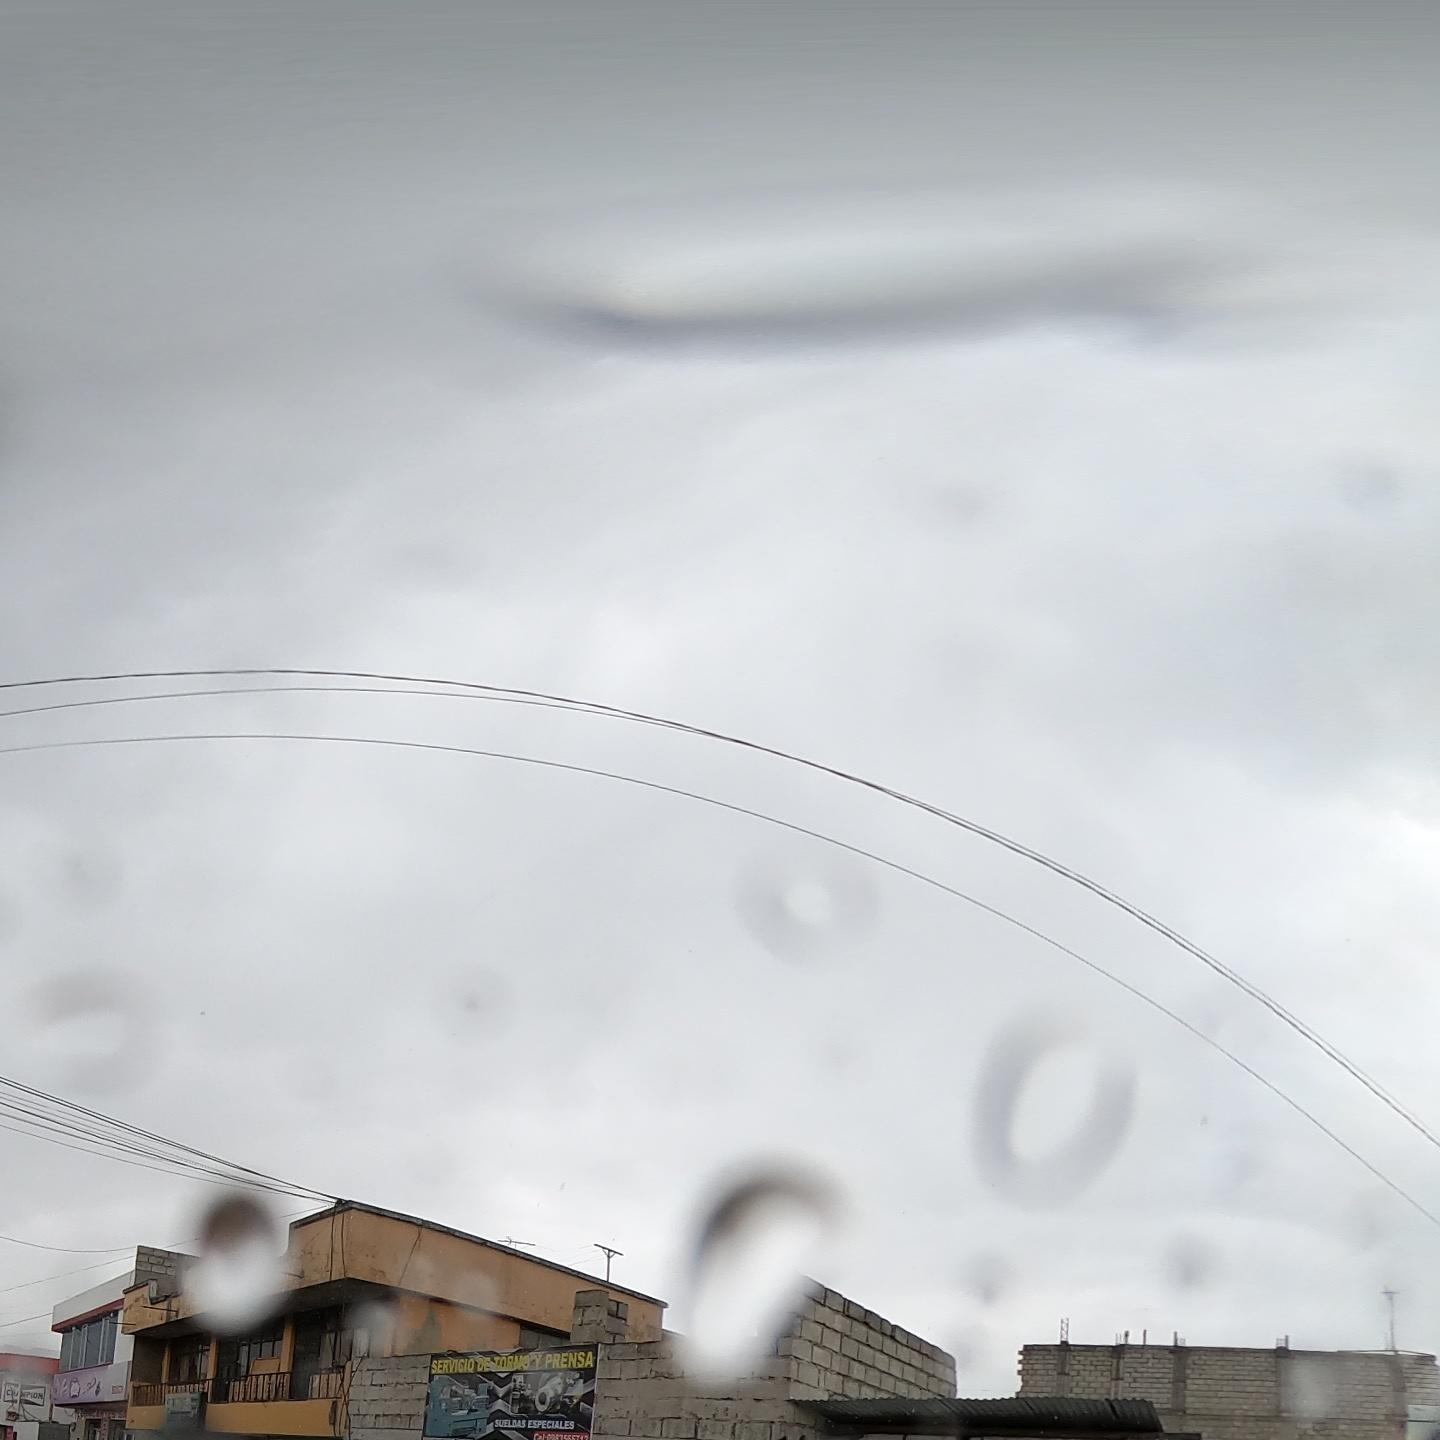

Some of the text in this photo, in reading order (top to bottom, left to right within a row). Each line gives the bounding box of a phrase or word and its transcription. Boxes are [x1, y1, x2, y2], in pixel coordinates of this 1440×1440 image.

[476, 1357, 491, 1373] DE
[545, 1350, 594, 1369] PRENSA
[494, 1419, 576, 1430] SUELDAS ESPECIALES
